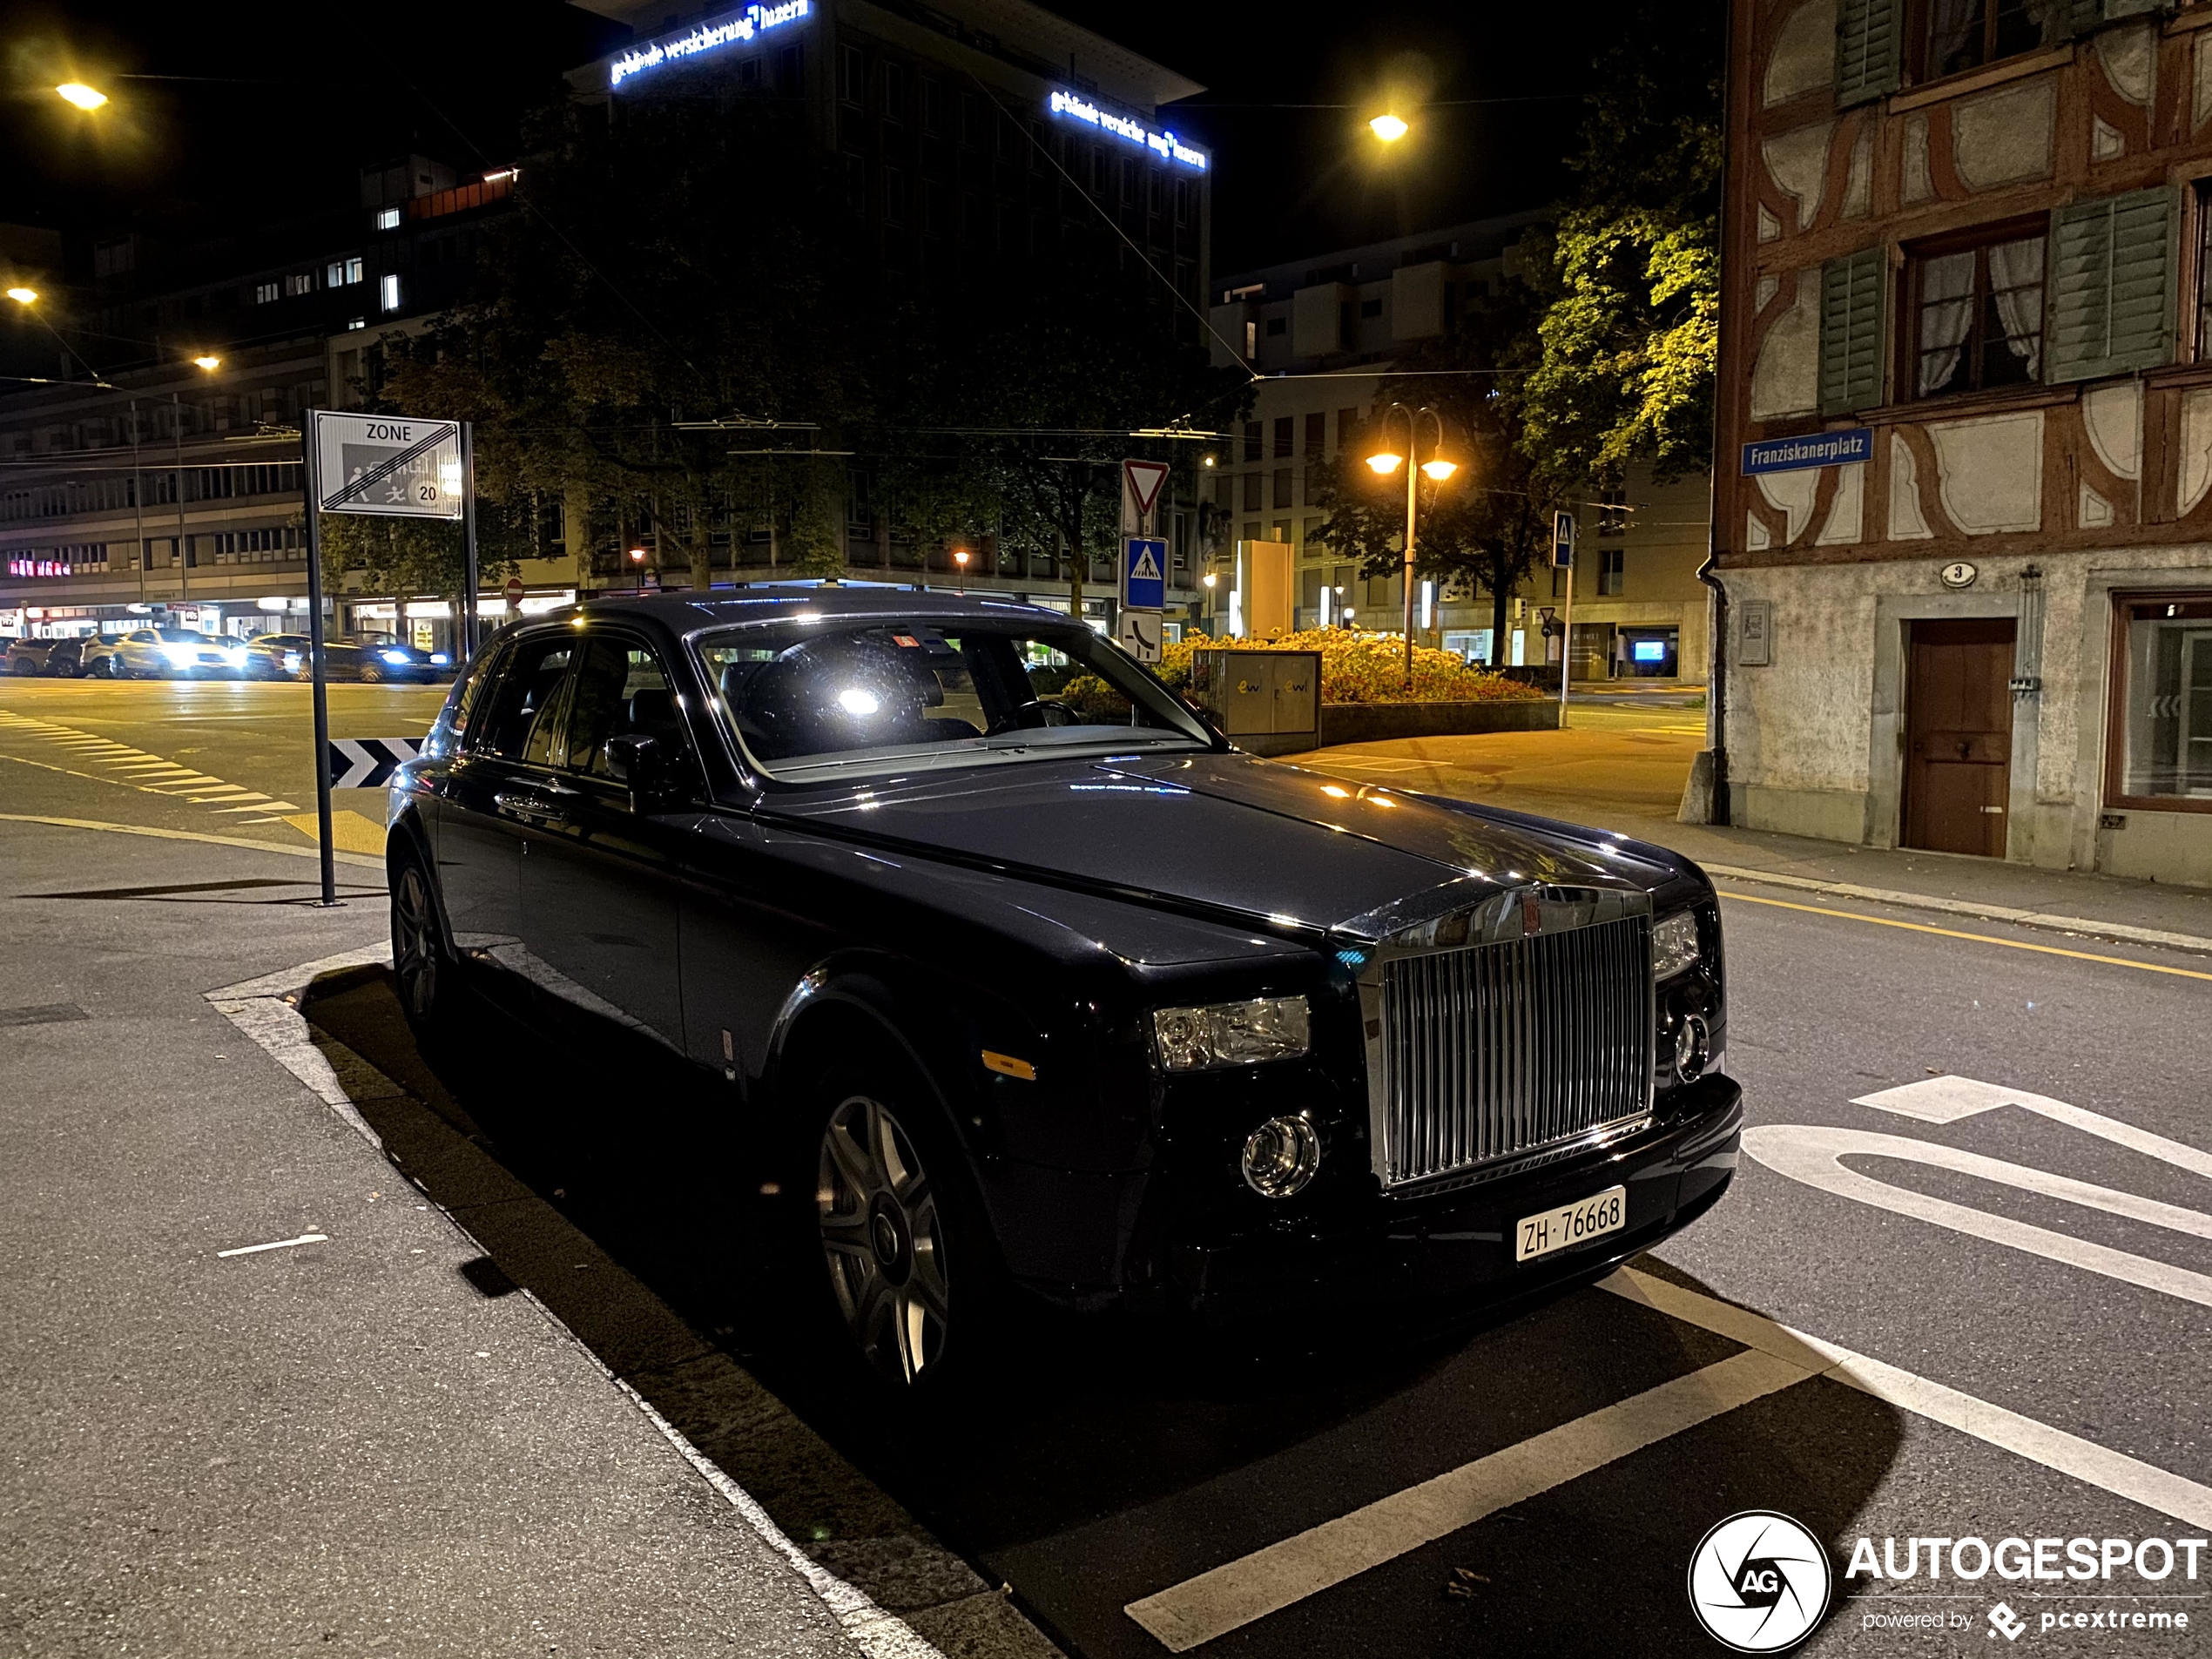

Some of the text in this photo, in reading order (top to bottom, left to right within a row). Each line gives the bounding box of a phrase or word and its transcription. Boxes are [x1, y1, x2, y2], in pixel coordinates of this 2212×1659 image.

[664, 17, 754, 58] versicherung
[759, 0, 808, 29] luzern
[367, 423, 411, 442] ZONE
[1751, 436, 1863, 466] Franziskanerplatz
[420, 486, 436, 501] 20
[1954, 565, 1962, 578] 3
